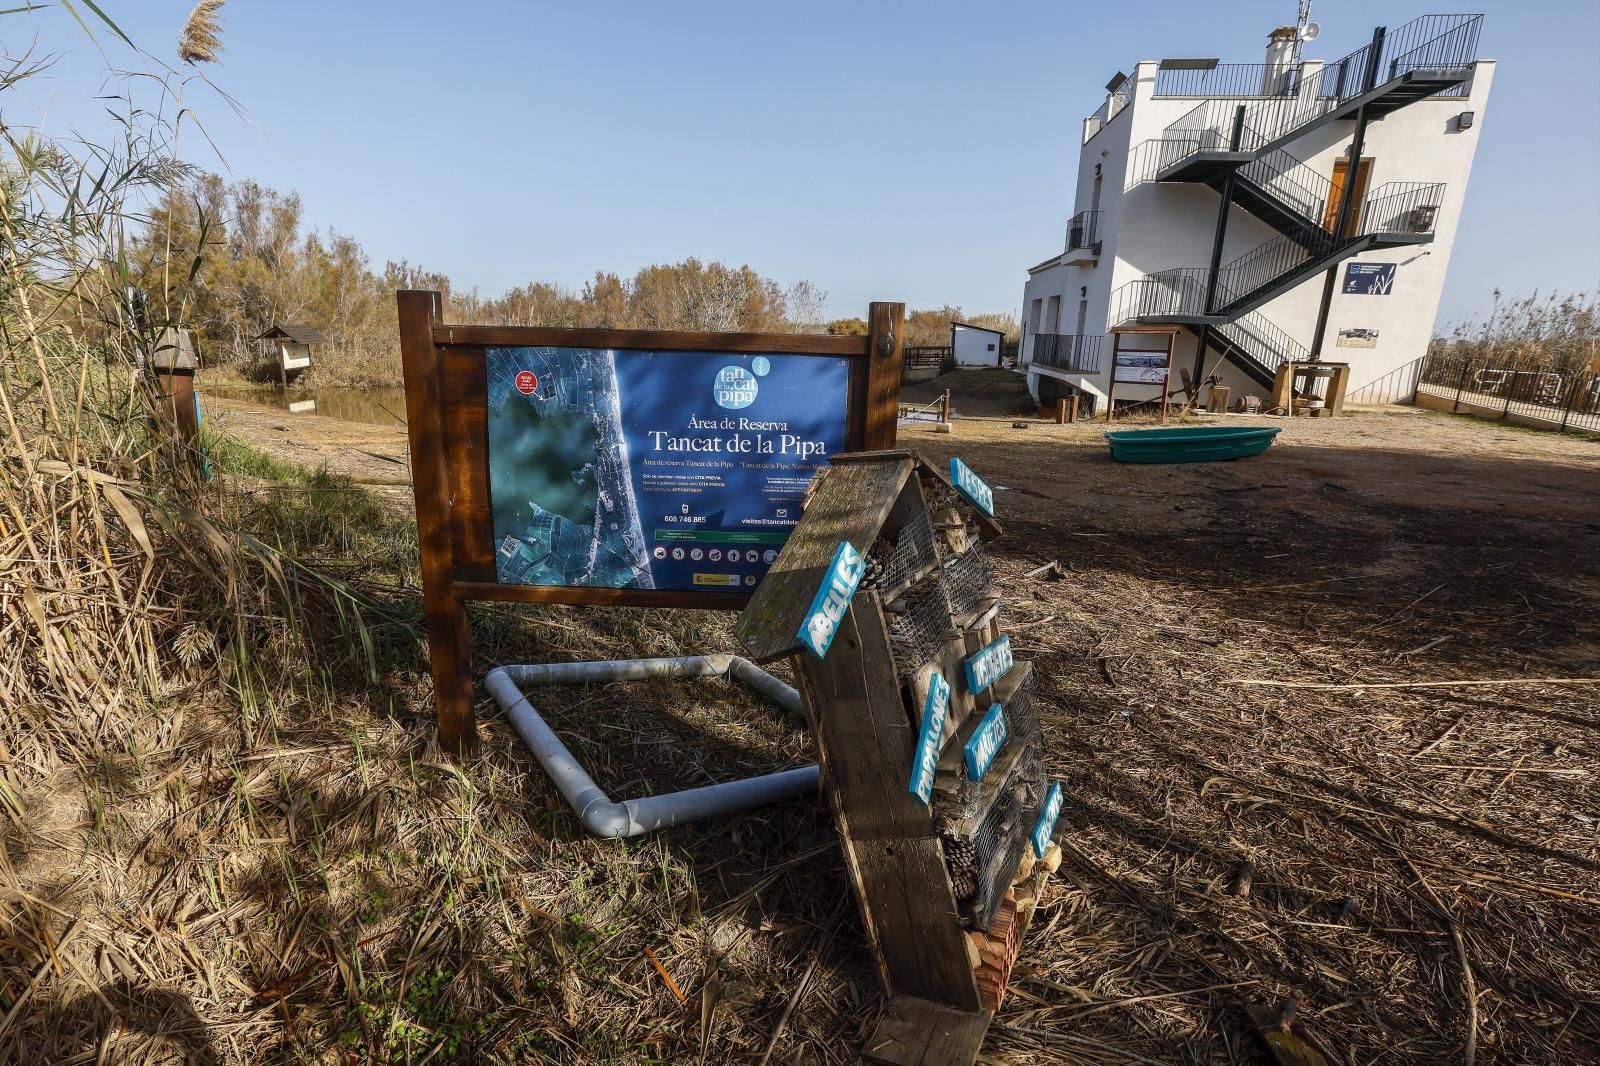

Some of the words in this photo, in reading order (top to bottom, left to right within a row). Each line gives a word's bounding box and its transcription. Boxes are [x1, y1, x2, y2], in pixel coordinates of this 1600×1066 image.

[714, 382, 723, 390] de
[723, 382, 730, 390] la
[719, 367, 745, 383] tan
[718, 390, 753, 406] pipa
[687, 414, 718, 429] Área
[720, 417, 736, 430] de
[738, 417, 788, 431] Reserva
[648, 431, 722, 451] Tancat
[726, 433, 751, 452] de
[756, 434, 774, 454] la
[779, 434, 827, 460] Pipa
[957, 461, 994, 516] VESPES
[807, 544, 863, 656] ABELLES
[918, 680, 950, 803] PAPALLONES
